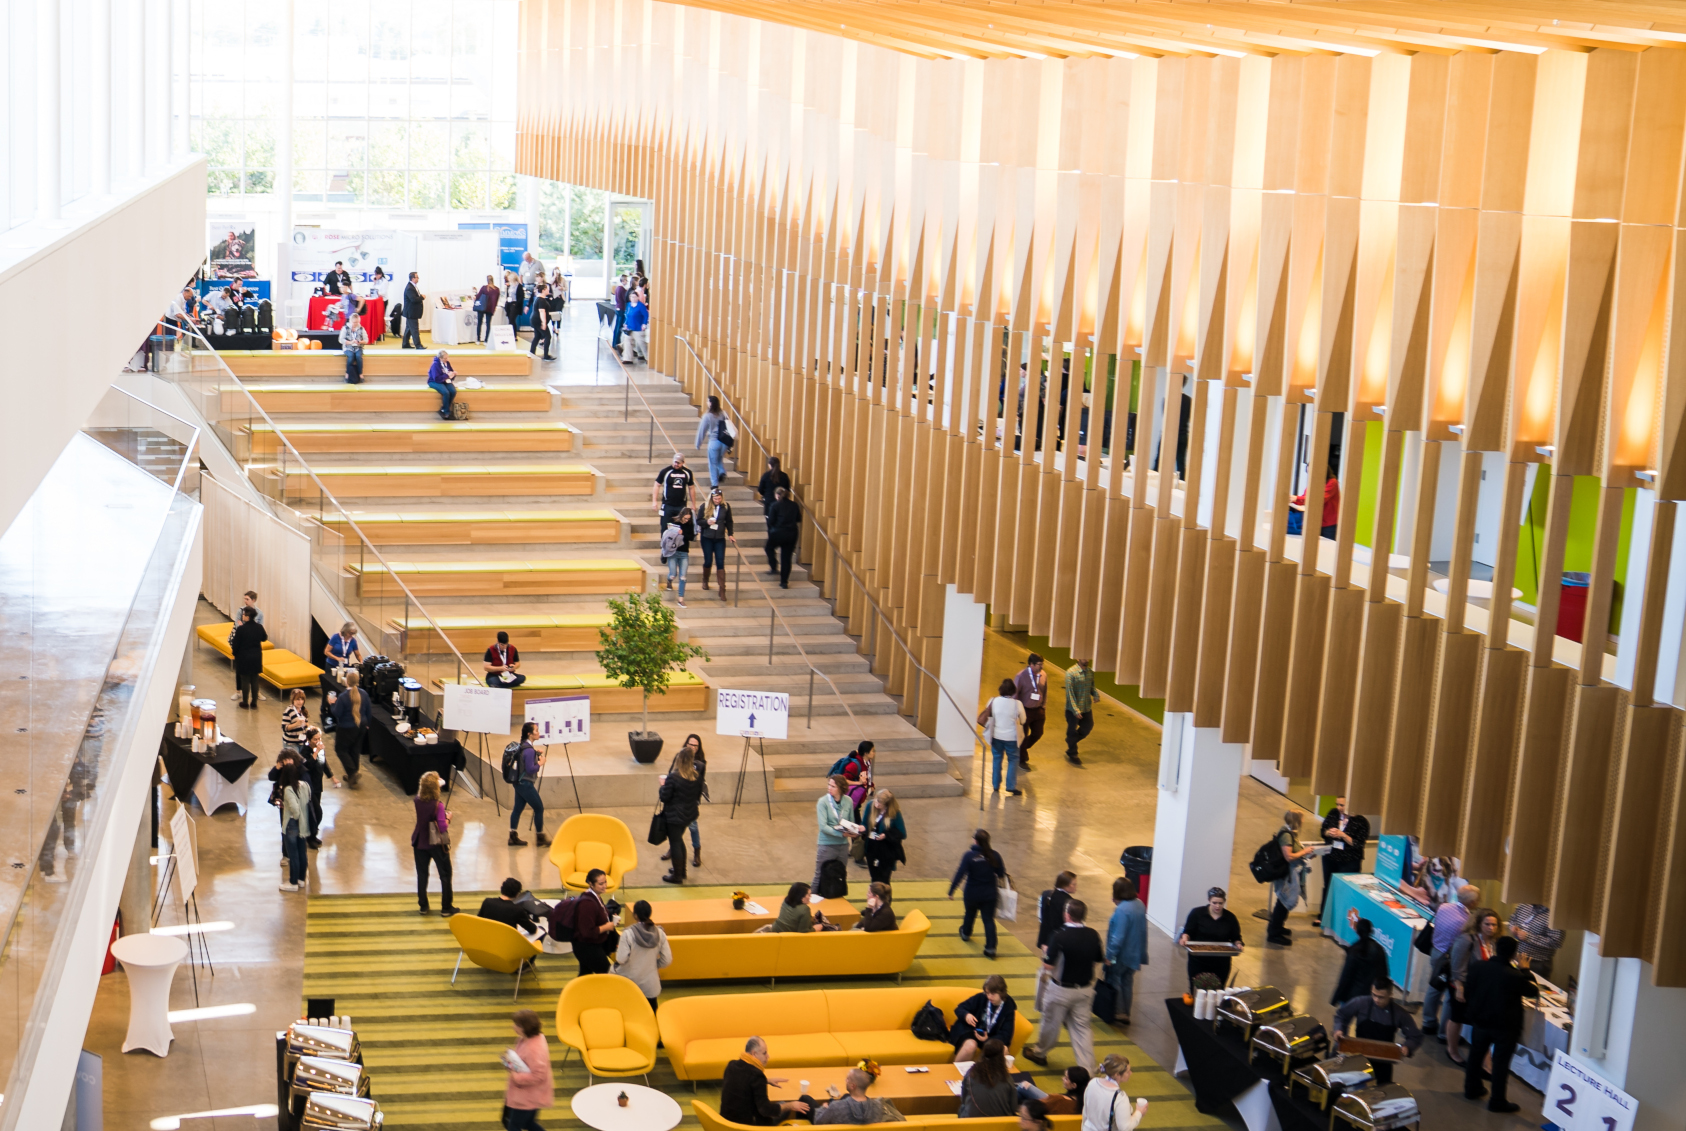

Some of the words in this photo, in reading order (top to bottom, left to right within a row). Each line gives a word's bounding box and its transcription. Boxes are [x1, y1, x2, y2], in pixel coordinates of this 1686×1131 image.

[718, 692, 787, 712] REGISTRATION
[1556, 1083, 1577, 1118] 2
[1557, 1056, 1602, 1092] LECTURE
[1604, 1086, 1630, 1110] HALL
